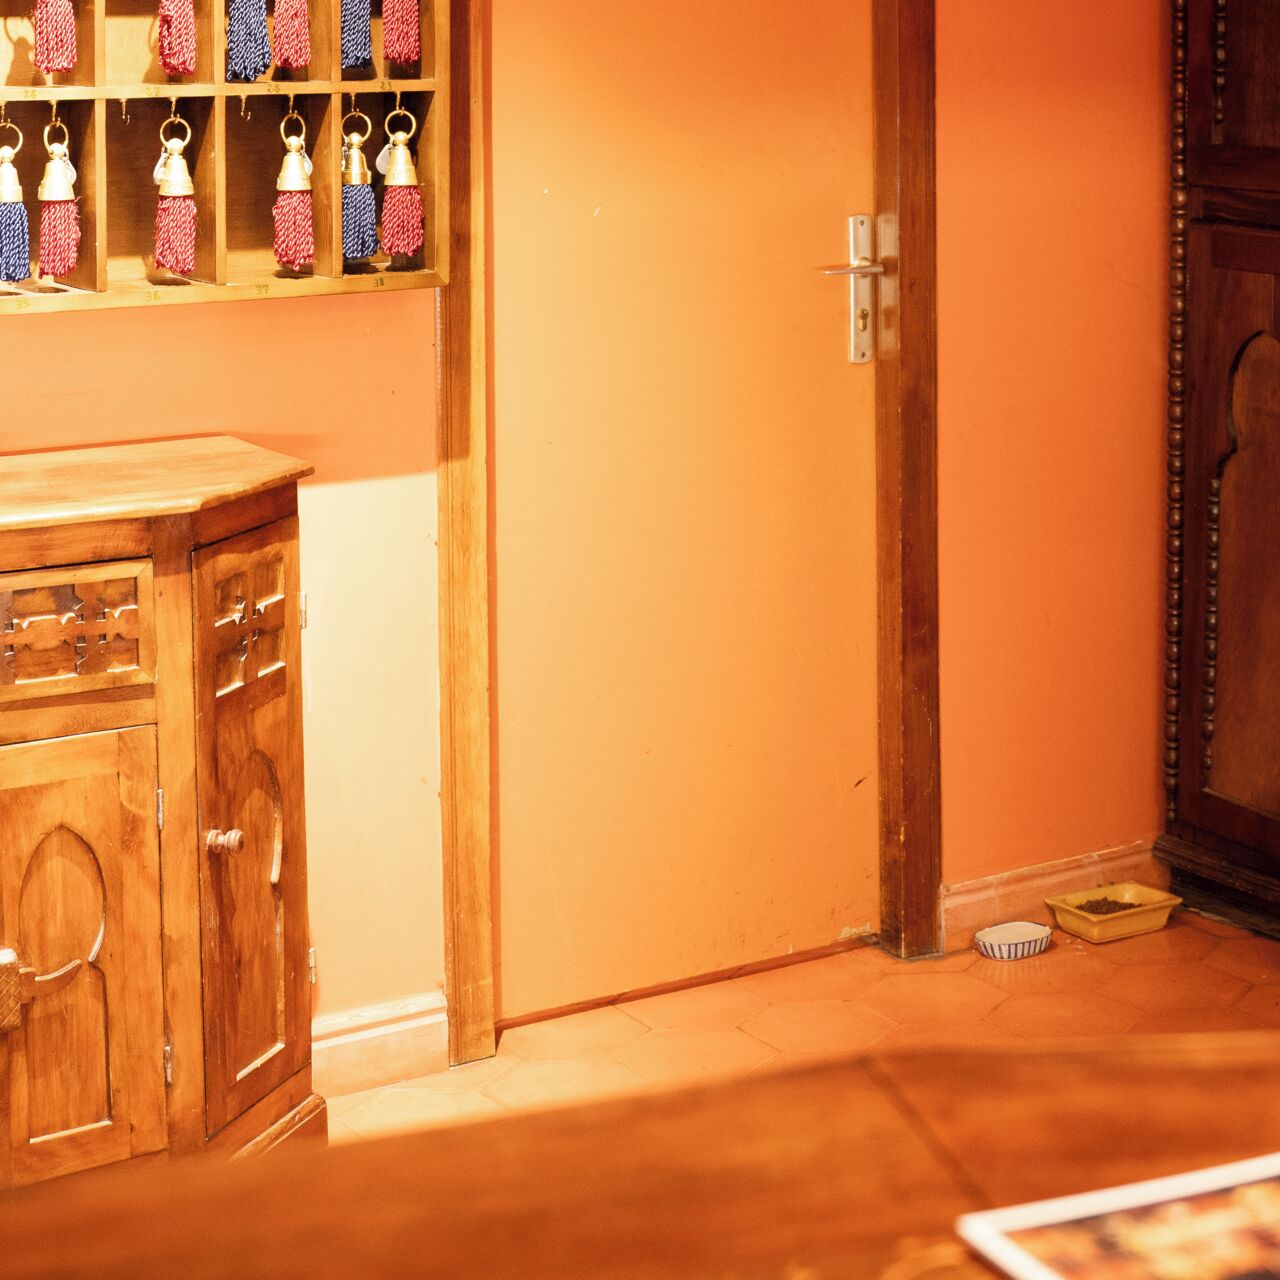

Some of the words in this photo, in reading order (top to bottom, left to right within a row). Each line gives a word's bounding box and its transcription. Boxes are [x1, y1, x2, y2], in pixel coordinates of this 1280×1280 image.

[372, 277, 385, 288] 38
[255, 283, 269, 295] 37
[144, 290, 160, 302] 36
[15, 297, 29, 310] 35
